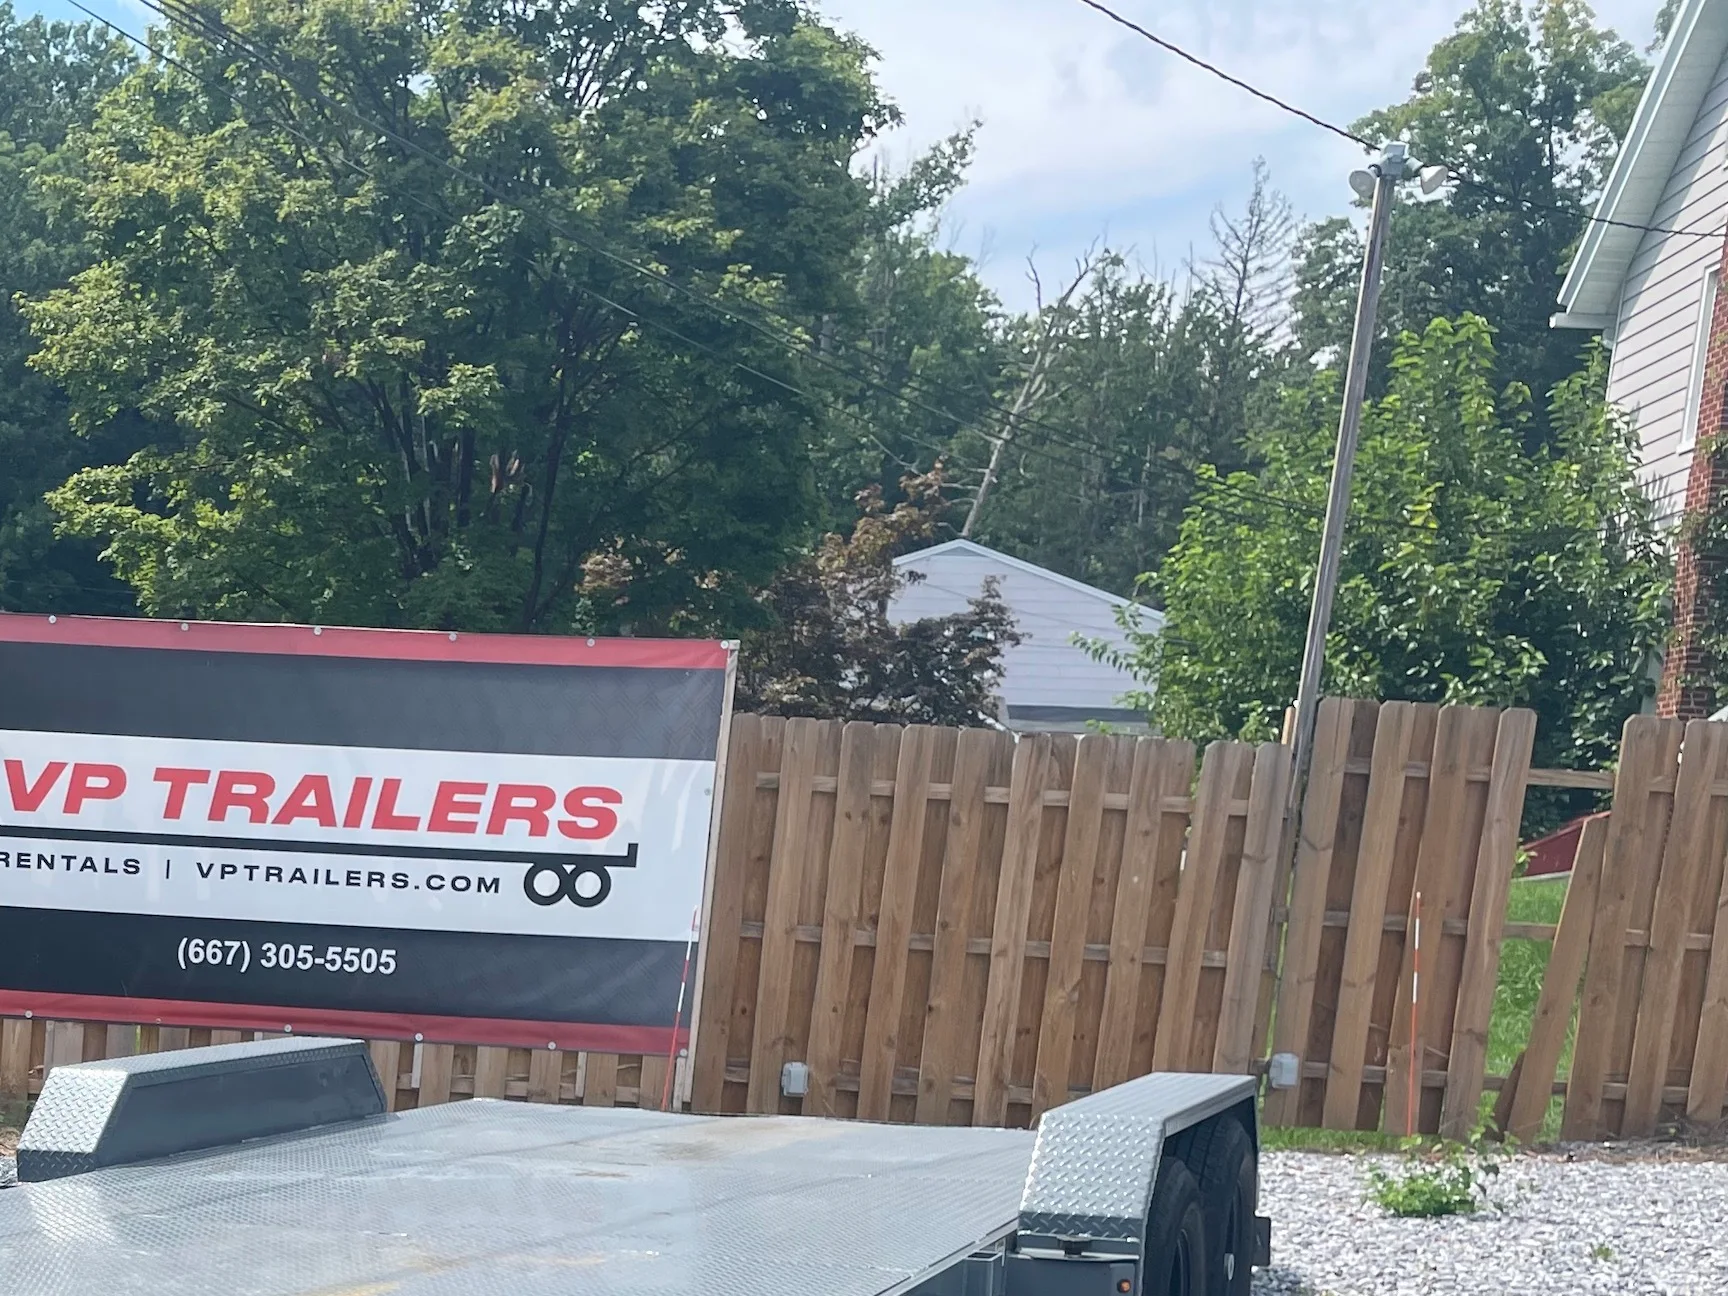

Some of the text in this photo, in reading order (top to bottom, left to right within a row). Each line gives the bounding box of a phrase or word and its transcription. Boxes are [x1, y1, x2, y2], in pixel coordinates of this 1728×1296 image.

[3, 758, 624, 841] VP TRAILERS
[194, 861, 502, 895] VPTRAILERS.COM
[176, 937, 398, 976] (667) 305-5505
